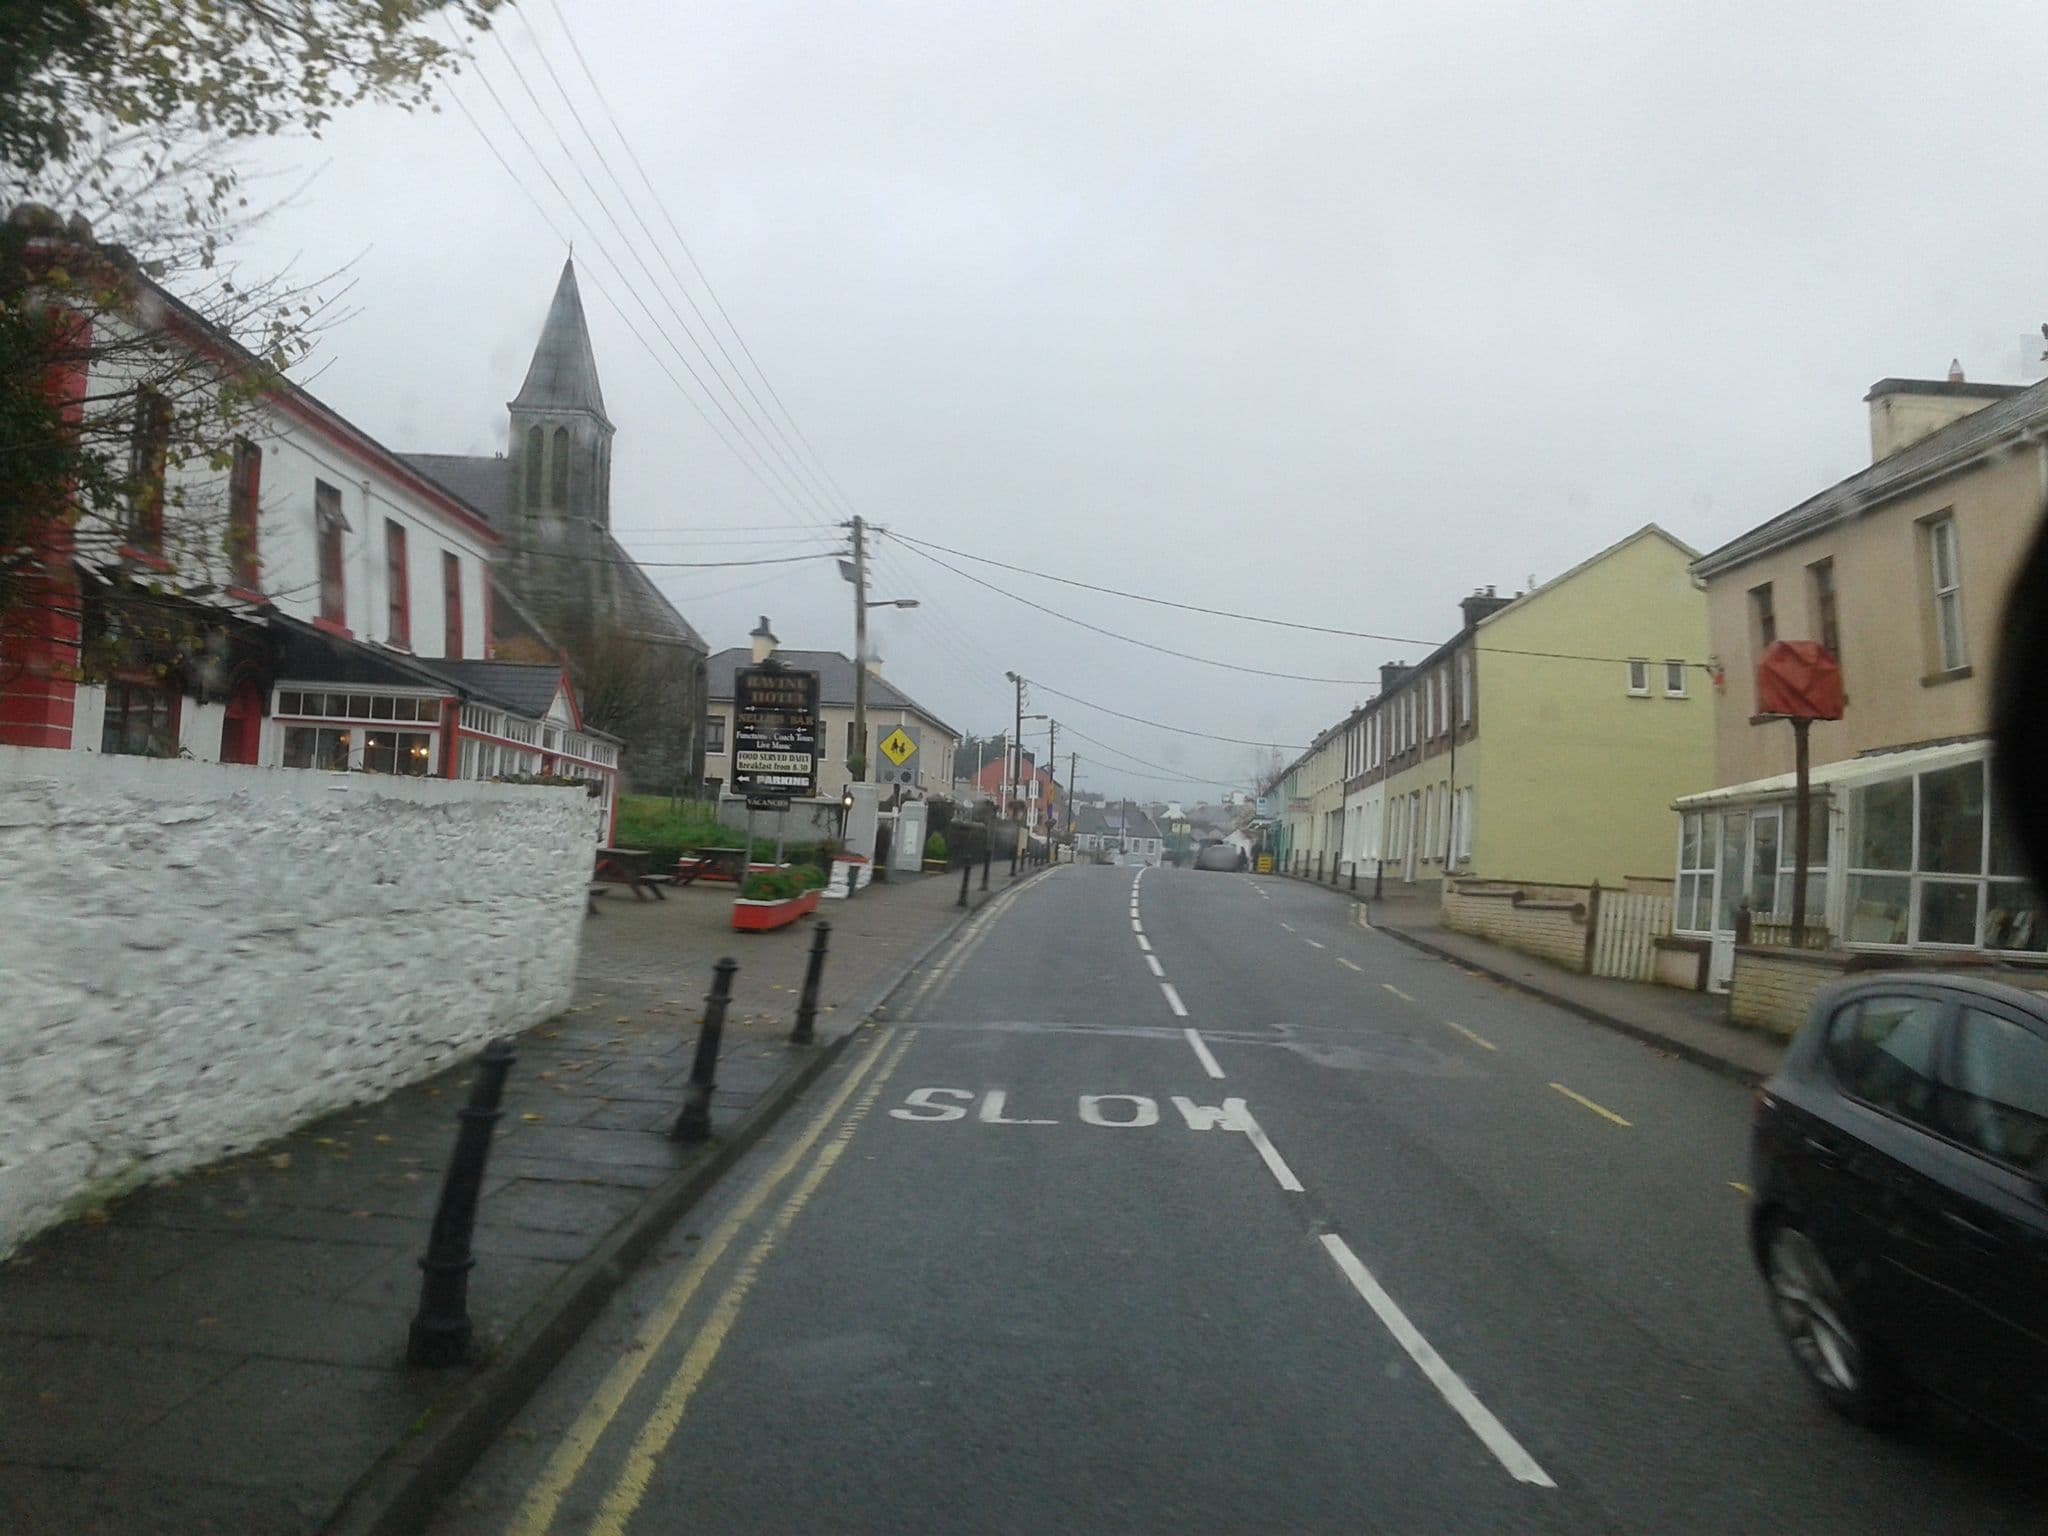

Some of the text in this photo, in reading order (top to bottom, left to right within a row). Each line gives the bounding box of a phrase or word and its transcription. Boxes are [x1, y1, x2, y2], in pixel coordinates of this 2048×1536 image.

[773, 732, 795, 742] Coach
[738, 752, 809, 763] FOOD SERVED DAILY
[738, 762, 773, 770] Breakfast
[774, 762, 792, 771] from
[756, 775, 810, 787] PARKING
[888, 1087, 1250, 1131] SLOW
